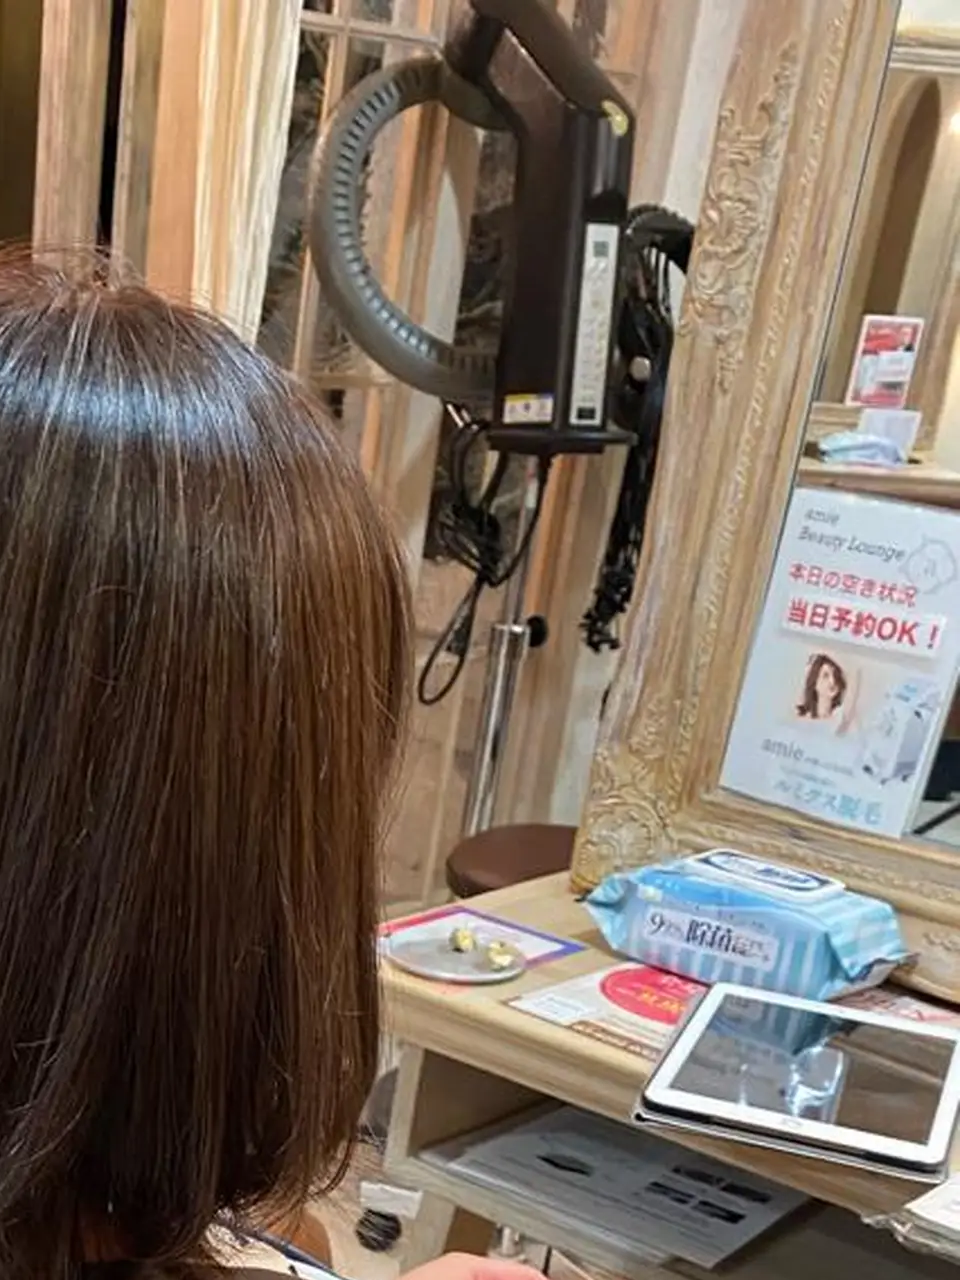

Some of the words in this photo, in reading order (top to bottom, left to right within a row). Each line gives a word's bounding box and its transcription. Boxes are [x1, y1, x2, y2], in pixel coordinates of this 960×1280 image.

[798, 525, 846, 551] Beauty
[847, 535, 906, 562] Lounge
[789, 563, 919, 608] 本日の空き状況
